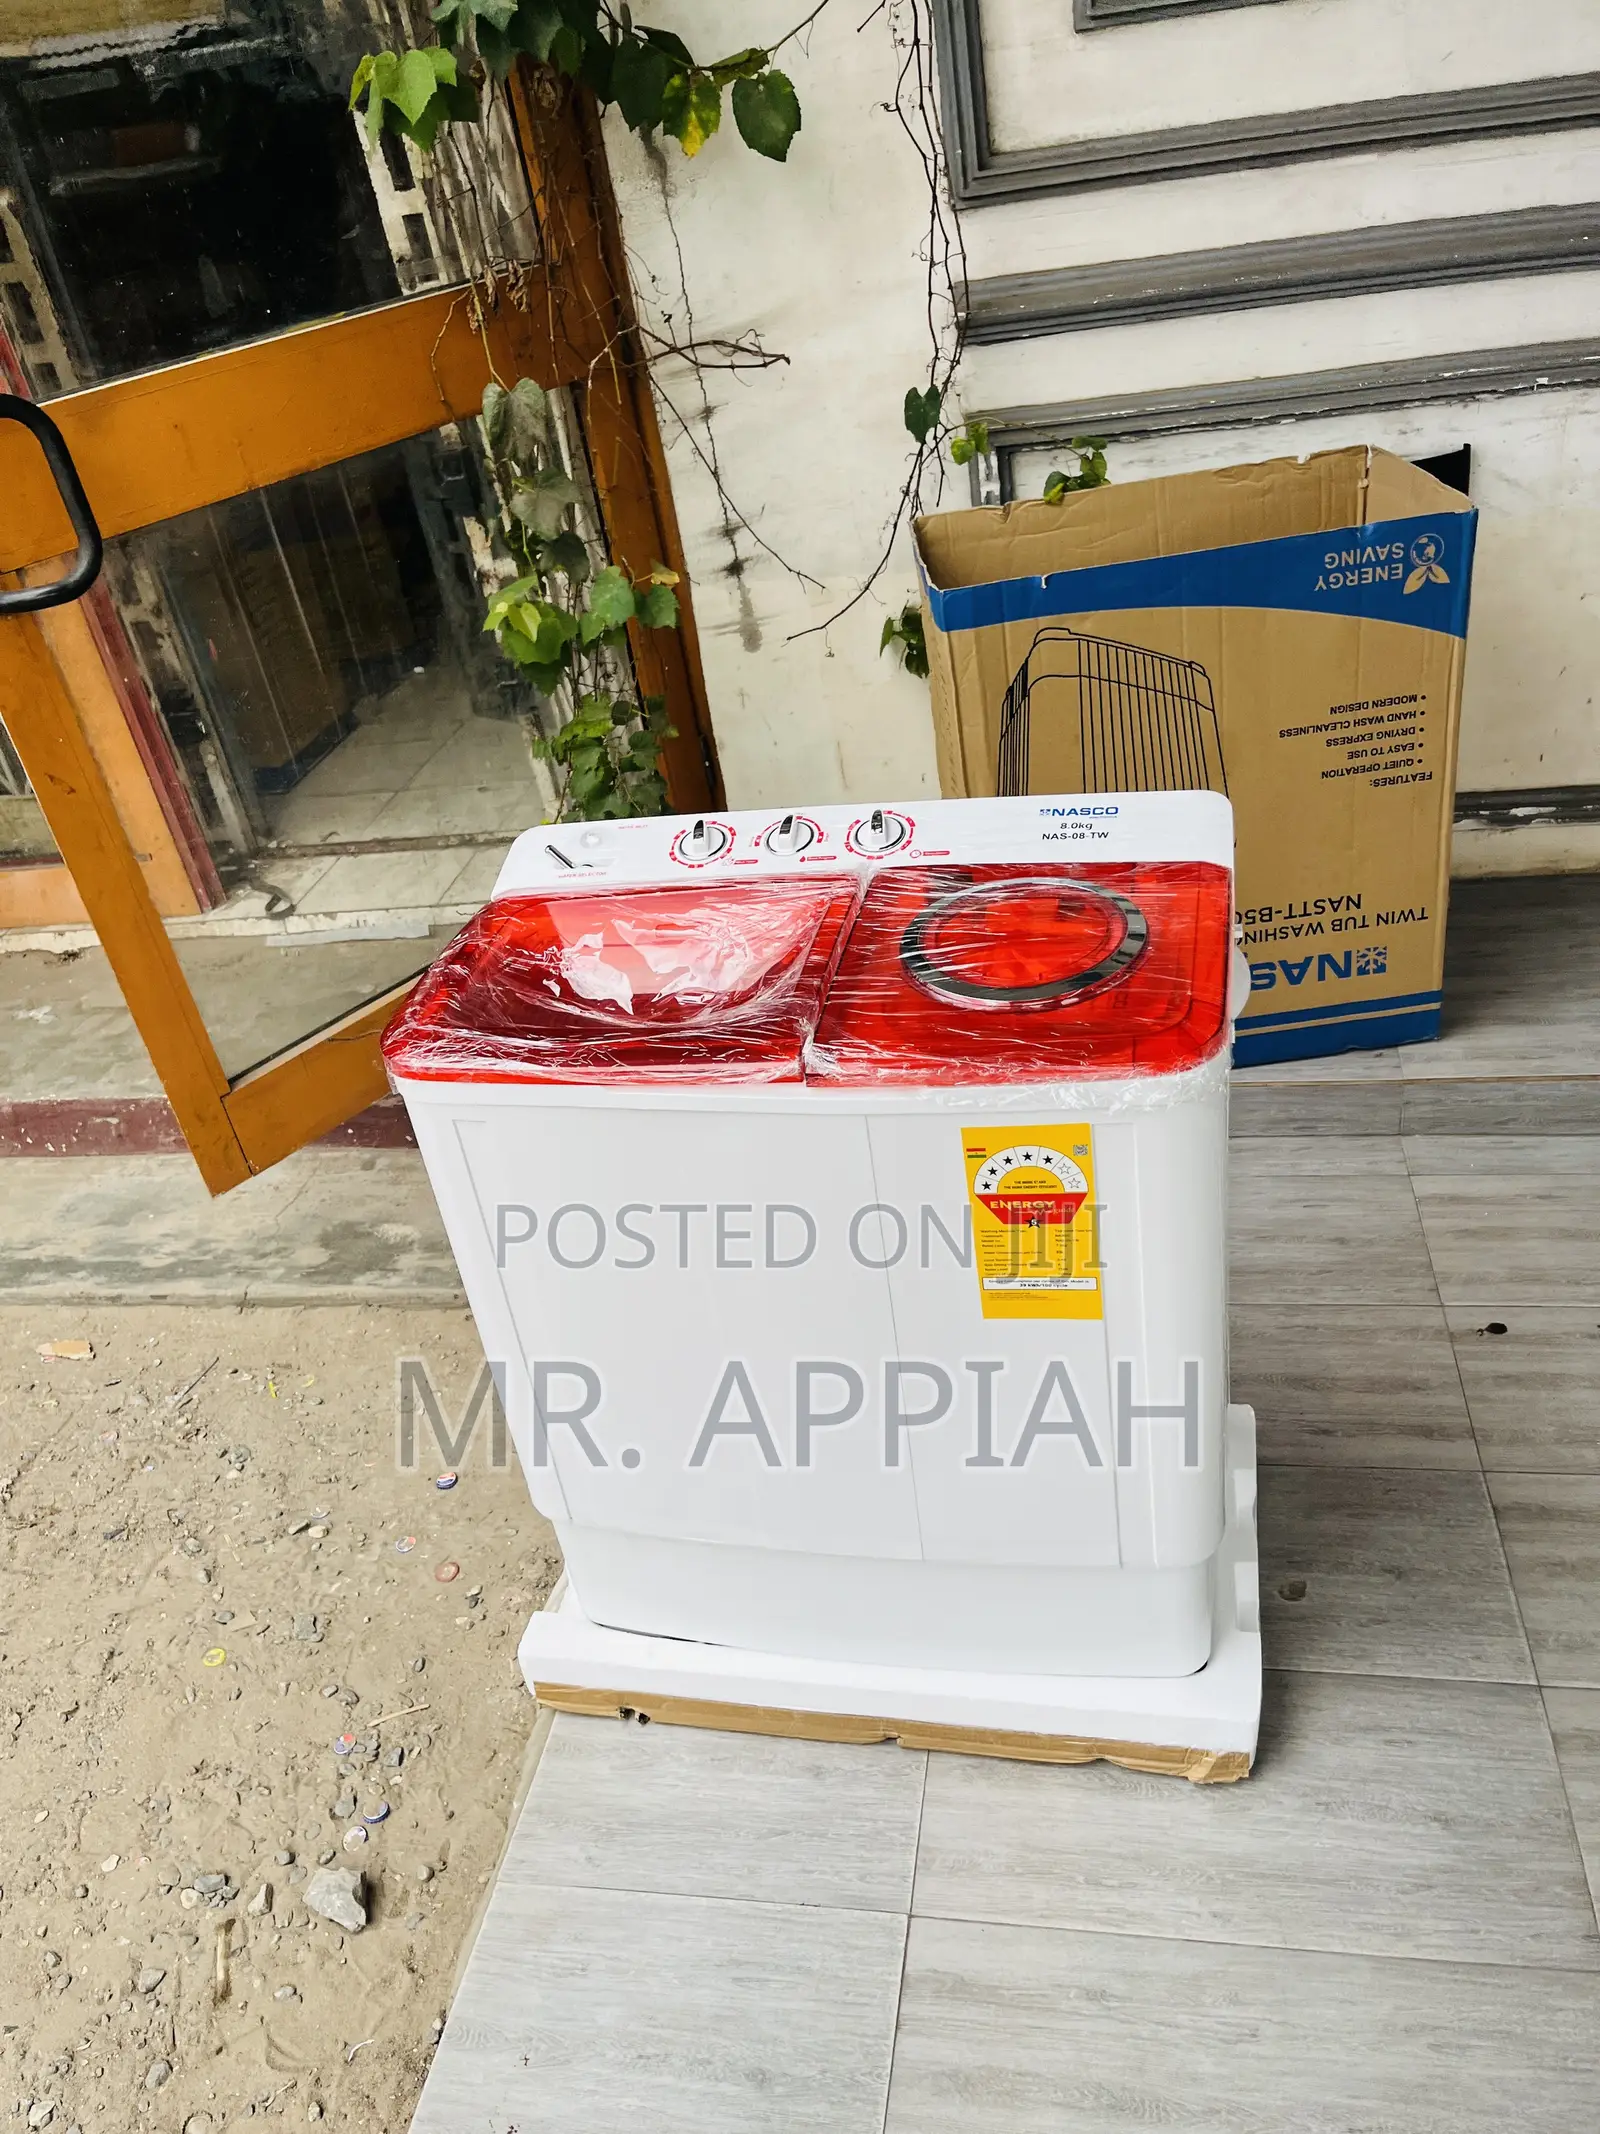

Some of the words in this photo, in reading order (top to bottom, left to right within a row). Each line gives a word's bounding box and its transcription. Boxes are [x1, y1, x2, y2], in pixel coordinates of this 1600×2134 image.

[1324, 542, 1405, 570] SAVING
[1313, 563, 1404, 592] ENERGY
[1329, 701, 1369, 715] DESIGN
[1371, 694, 1418, 709] MODERN
[1353, 715, 1385, 728] WASH
[1386, 710, 1417, 722] HAND
[1278, 720, 1351, 738] CLEANLINESS
[1376, 726, 1416, 740] DRYING
[1325, 733, 1374, 747] EXPRESS
[1347, 750, 1368, 760] USE
[1370, 747, 1385, 757] TO
[1386, 742, 1415, 754] EASY
[1321, 762, 1381, 779] OPERATION
[1383, 758, 1415, 771] QUIET
[1369, 771, 1433, 787] FEATURES:
[1051, 806, 1119, 817] NASCO
[1060, 822, 1093, 831] 8.0kg
[1042, 831, 1109, 840] NAS-08-TW
[1331, 915, 1370, 932] TUB
[1376, 907, 1429, 927] TWIN
[990, 1200, 1055, 1211] ENERGY
